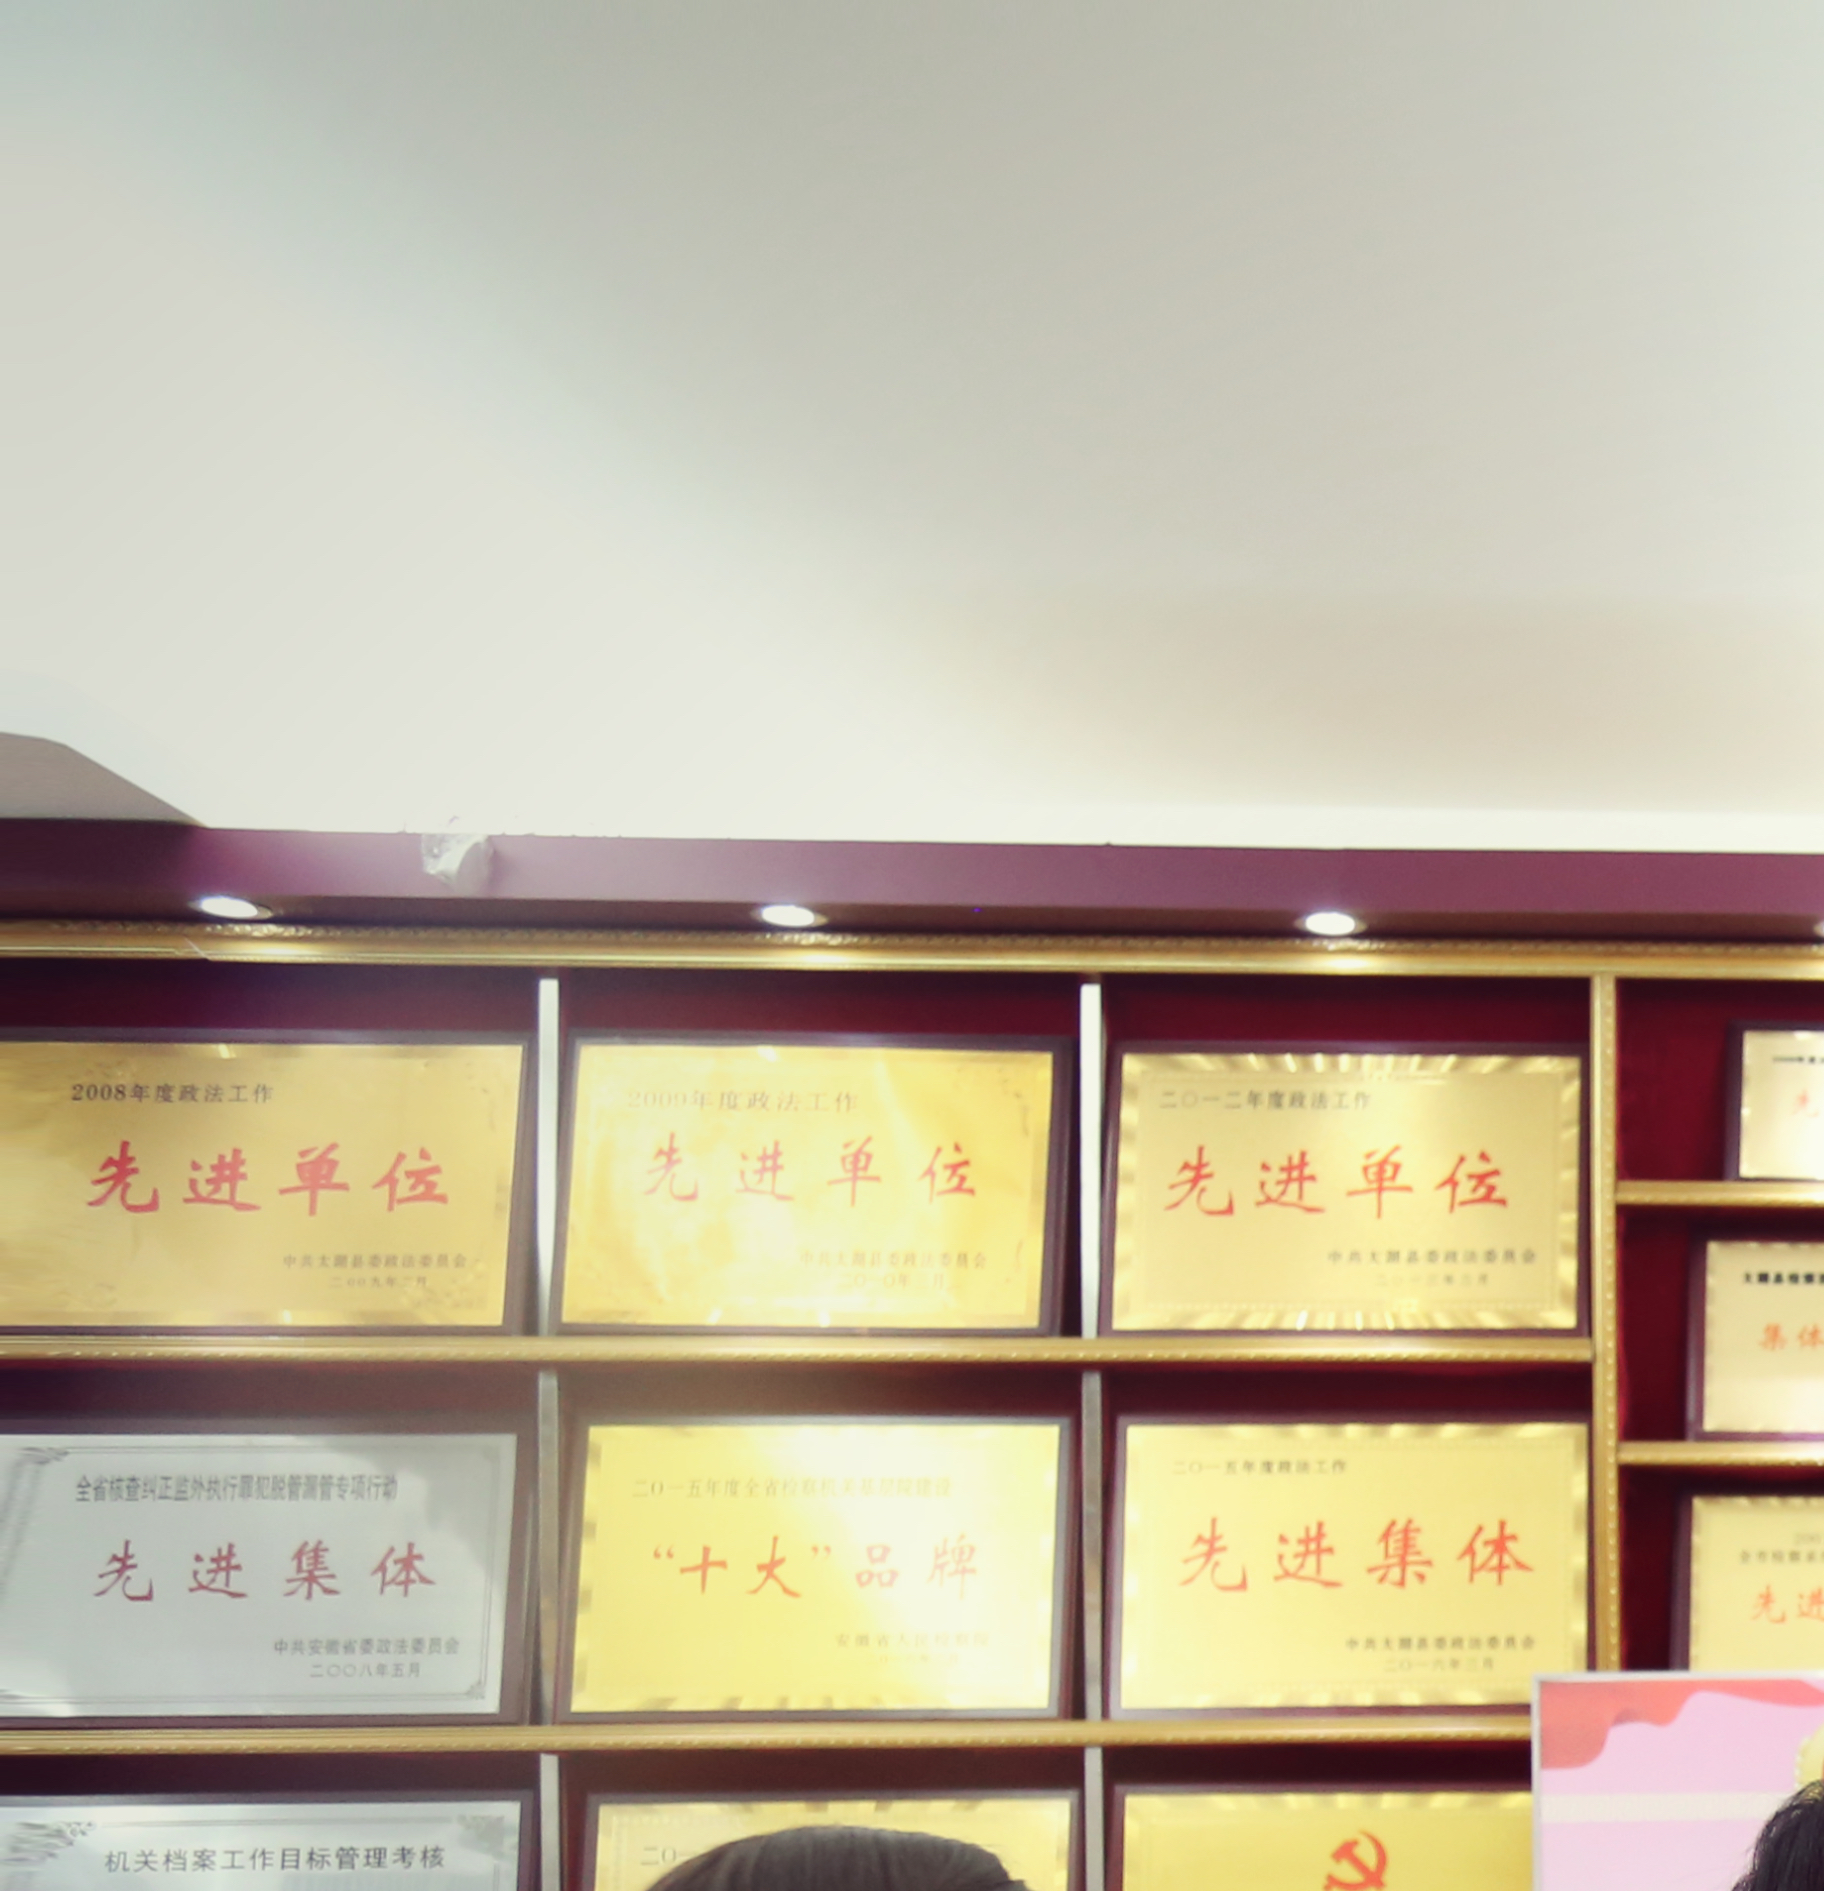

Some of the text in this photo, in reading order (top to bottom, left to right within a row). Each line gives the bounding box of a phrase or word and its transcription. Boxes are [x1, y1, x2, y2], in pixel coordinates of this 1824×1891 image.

[71, 1083, 275, 1104] 2008年度政法工作
[86, 1140, 449, 1217] 先进单位
[643, 1132, 977, 1207] 先进单位
[1164, 1145, 1509, 1219] 先进单位
[93, 1540, 437, 1601] 先进集体
[653, 1533, 979, 1601] “十大”品牌
[1178, 1517, 1535, 1592] 先进集体
[104, 1845, 447, 1873] 机关档案工作目标管理考核
